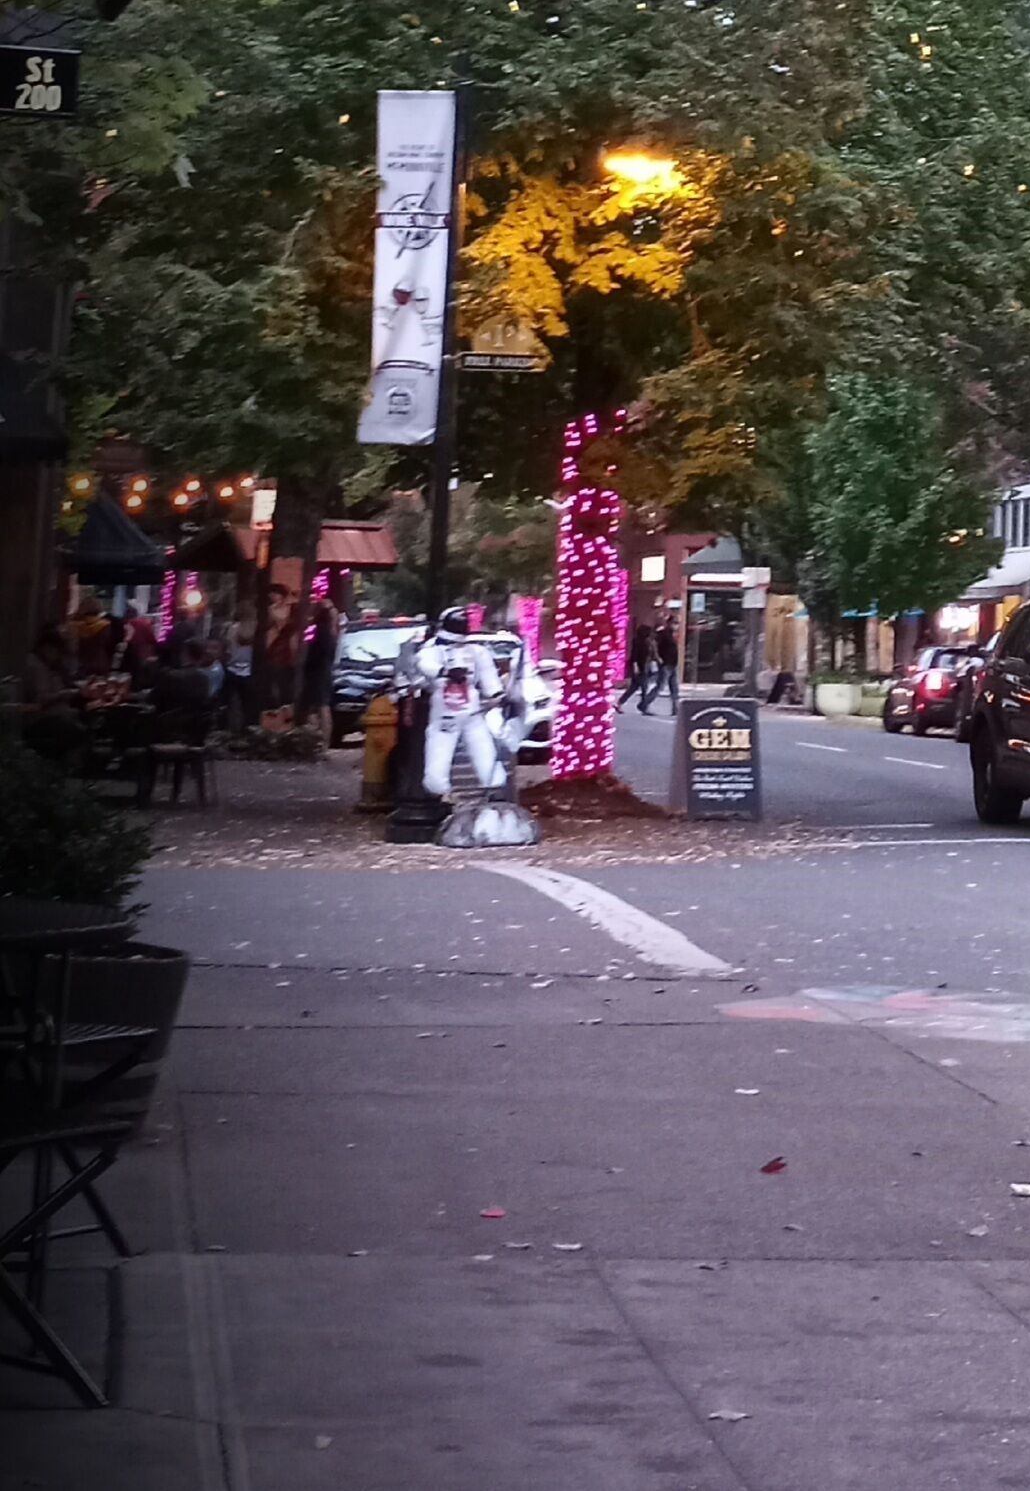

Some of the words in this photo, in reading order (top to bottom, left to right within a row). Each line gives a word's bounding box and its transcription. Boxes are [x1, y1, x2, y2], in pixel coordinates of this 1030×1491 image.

[24, 56, 56, 83] St
[15, 83, 62, 111] 200
[688, 728, 752, 749] GEM
